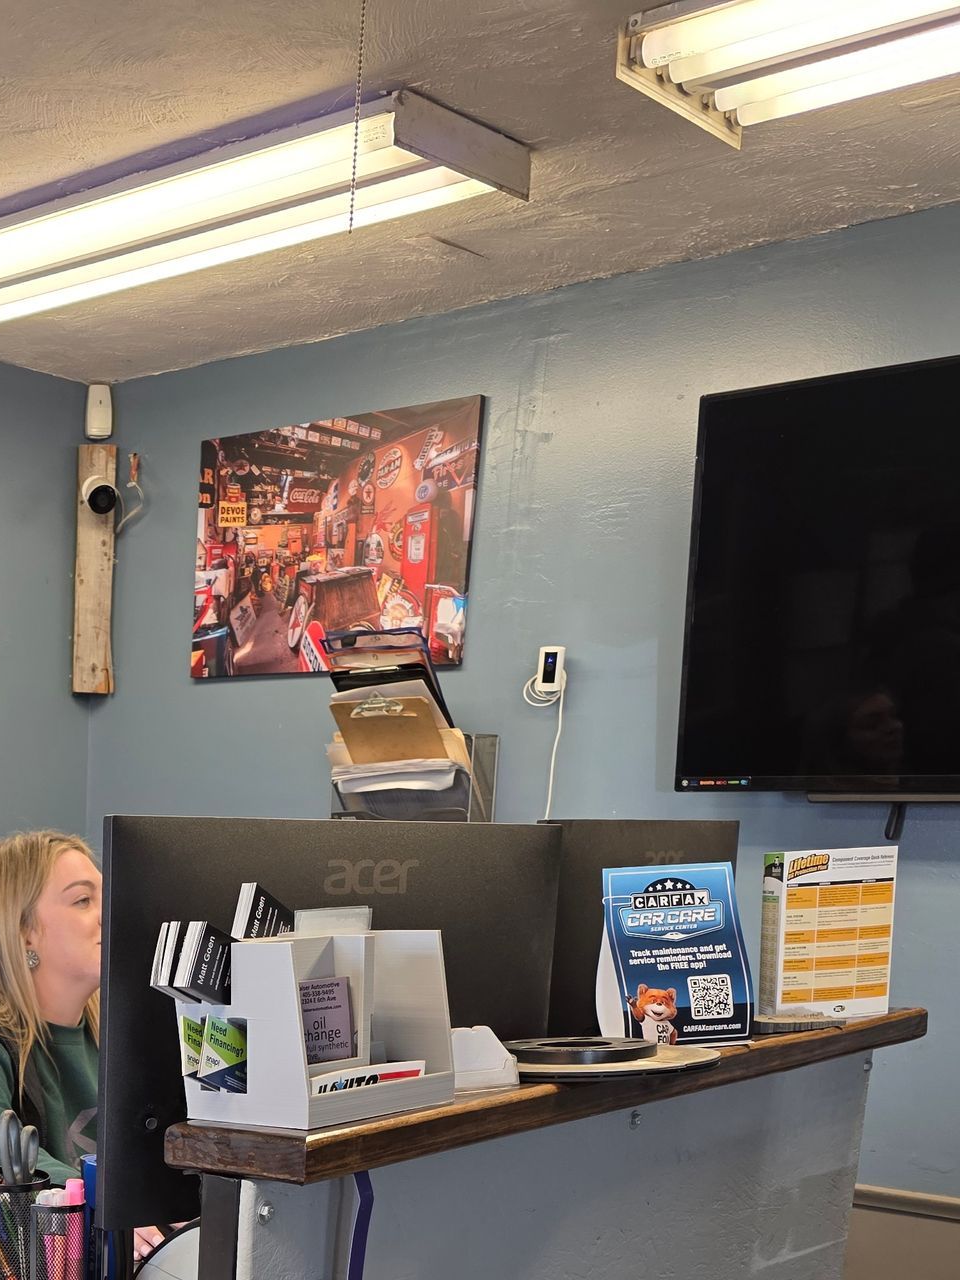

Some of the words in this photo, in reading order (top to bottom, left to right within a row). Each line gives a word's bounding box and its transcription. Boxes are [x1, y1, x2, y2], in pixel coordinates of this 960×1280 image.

[220, 506, 245, 515] DEVOE
[789, 854, 829, 872] Lifetime
[323, 859, 419, 896] acer
[256, 896, 266, 919] Goen
[635, 893, 707, 909] CARFAX
[627, 912, 665, 927] CAR
[667, 908, 716, 923] CARE
[628, 956, 656, 965] service
[656, 954, 695, 963] reminders.
[696, 951, 733, 960] Download
[630, 949, 651, 958] Track
[652, 946, 699, 956] maintenance
[699, 944, 714, 953] and
[714, 943, 727, 953] get
[197, 963, 208, 985] Matt
[203, 936, 216, 962] Goen
[657, 963, 670, 971] the
[671, 961, 690, 970] FREE
[690, 960, 707, 970] app!
[211, 1021, 227, 1036] Need
[313, 1016, 326, 1030] oil
[209, 1033, 244, 1057] Financing?
[318, 1040, 349, 1052] synthetic
